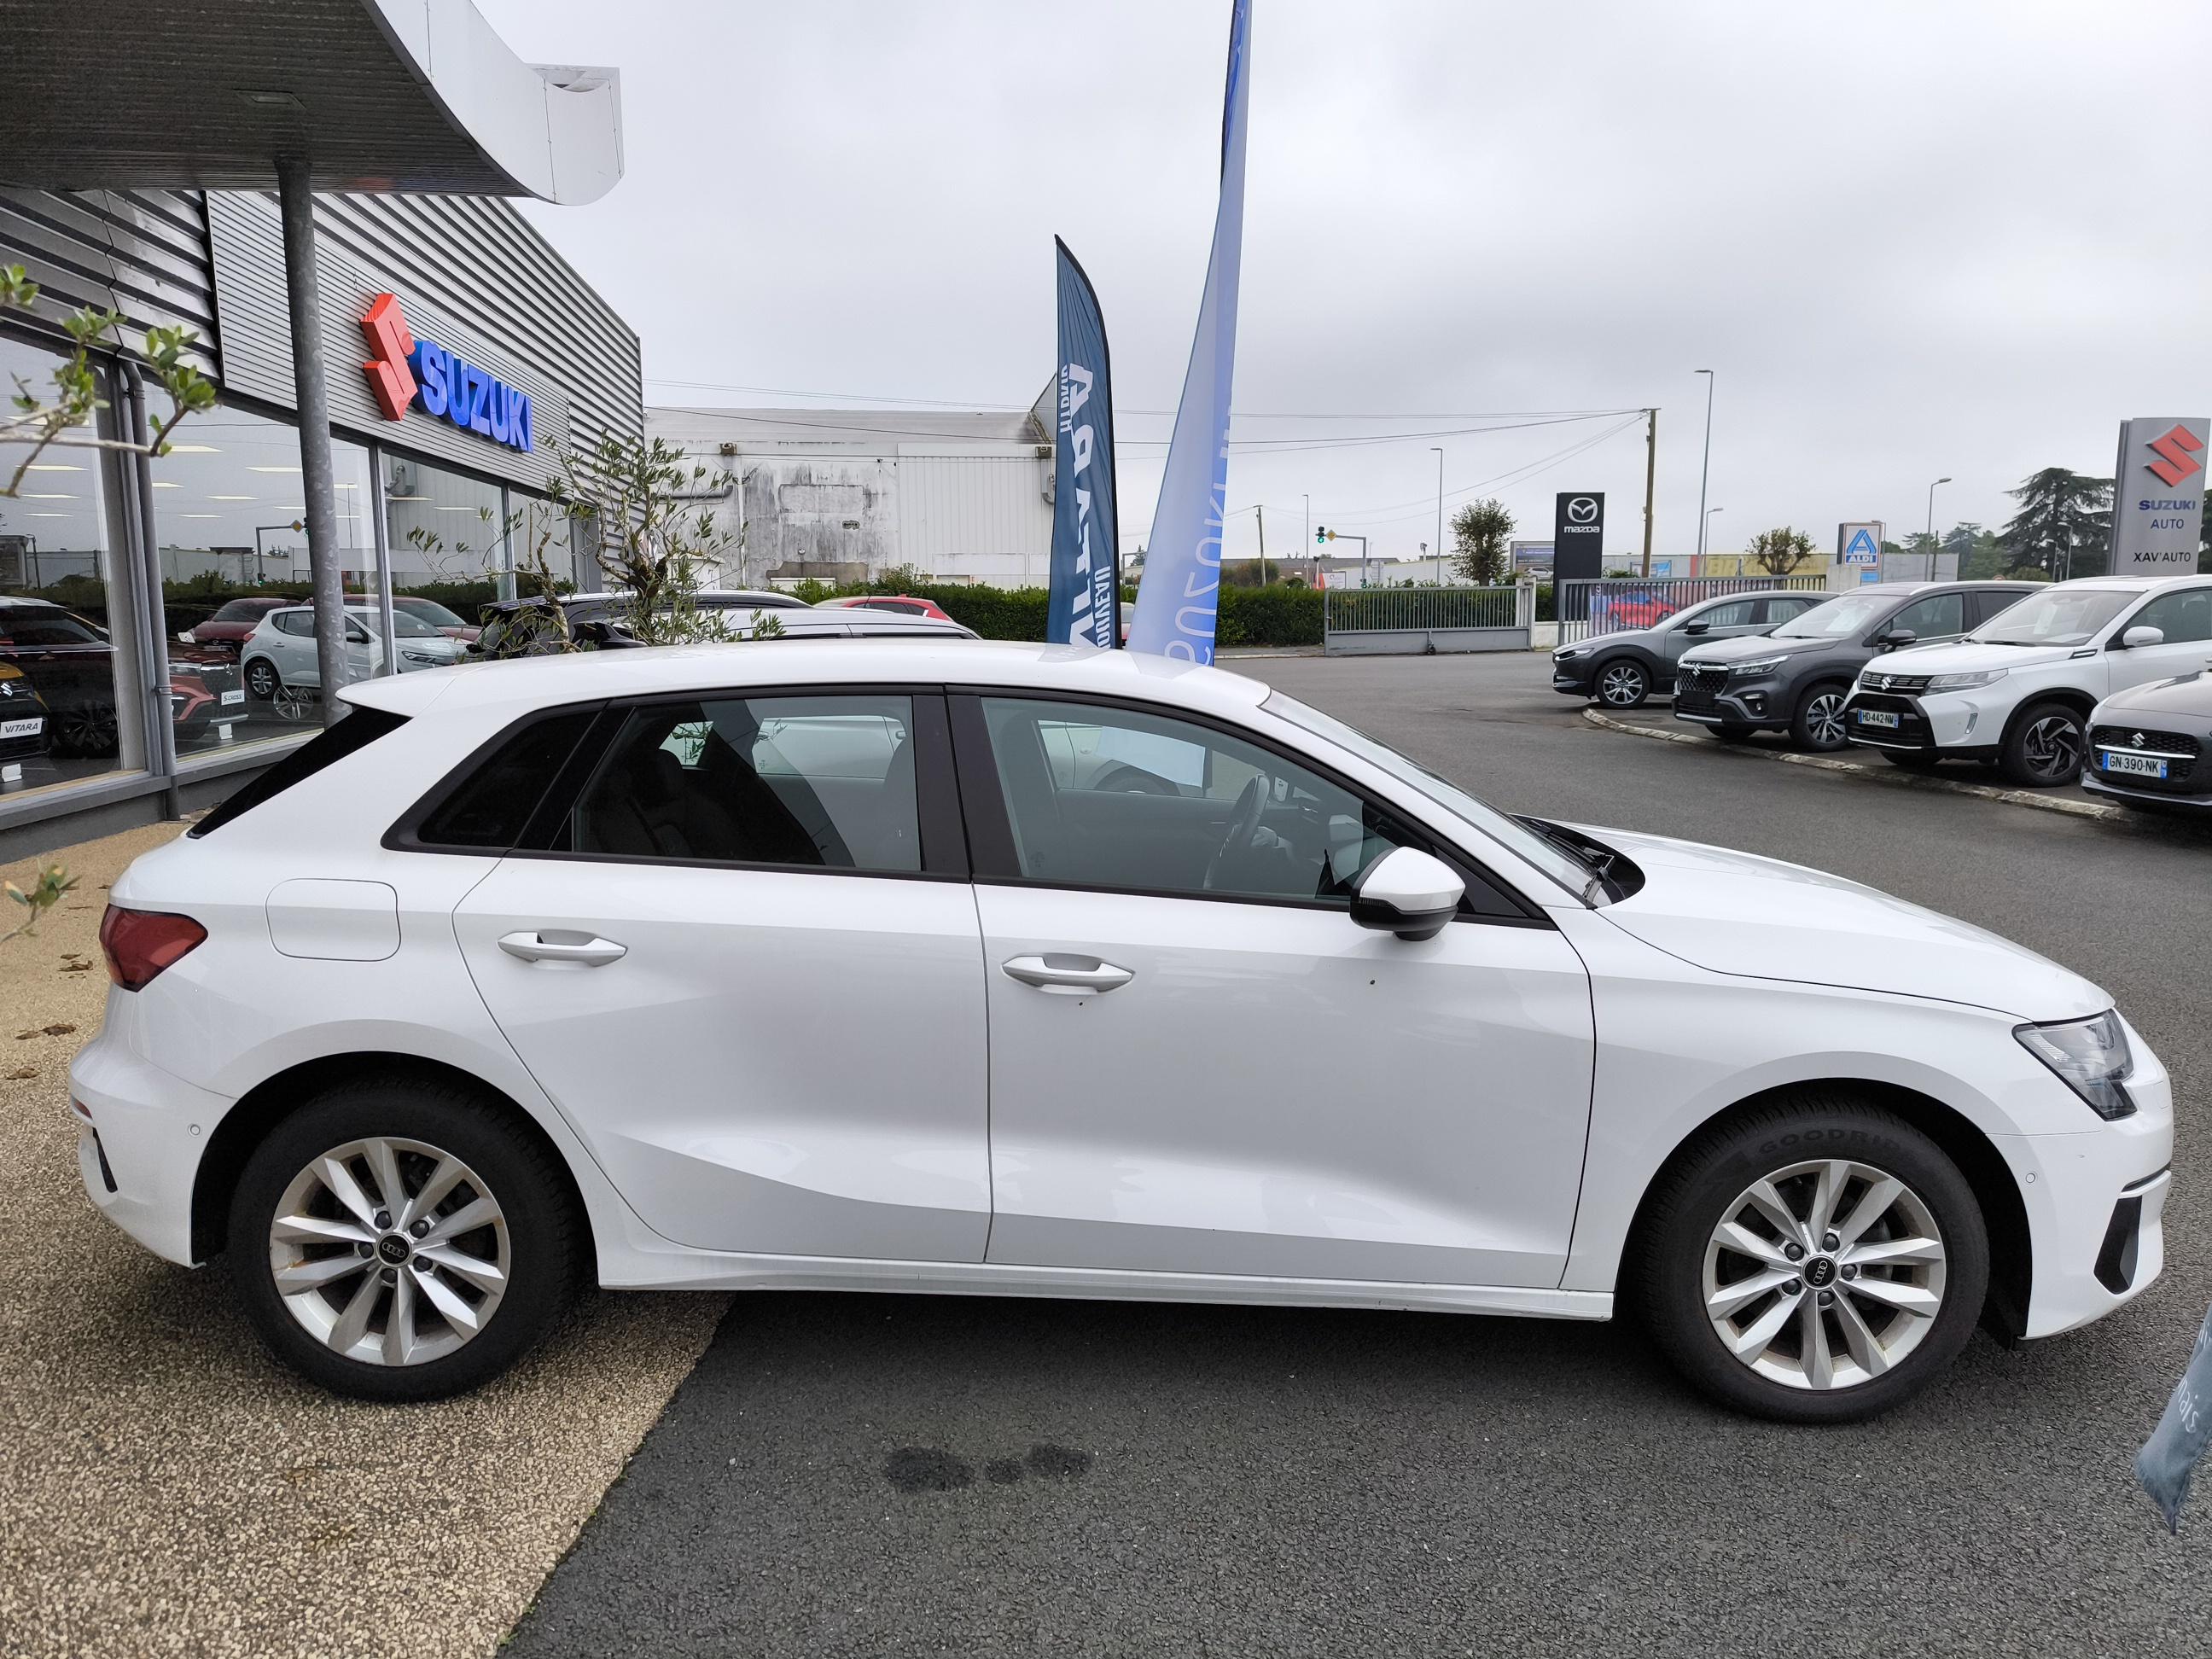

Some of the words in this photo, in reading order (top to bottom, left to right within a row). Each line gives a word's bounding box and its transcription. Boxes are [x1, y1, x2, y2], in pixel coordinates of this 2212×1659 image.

[409, 340, 534, 454] SUZUKI
[2139, 499, 2196, 510] SUZUKI
[2150, 518, 2185, 529] AUTO
[2133, 551, 2192, 562] XAV'AUTO
[5, 722, 38, 733] VITARA
[2109, 755, 2158, 773] GN-390-NK
